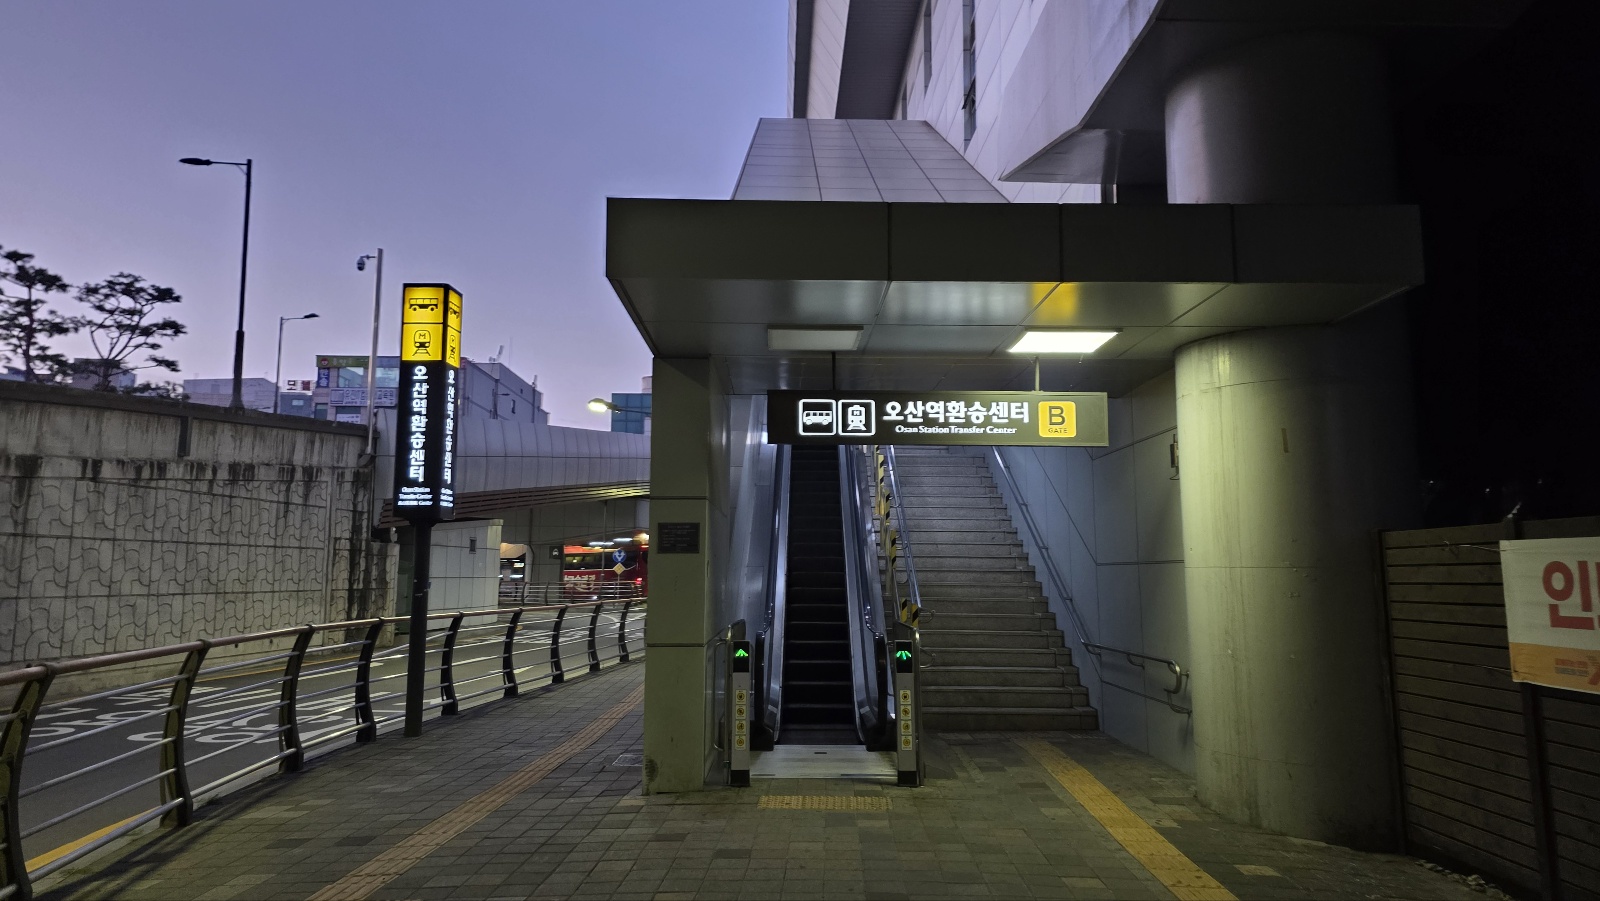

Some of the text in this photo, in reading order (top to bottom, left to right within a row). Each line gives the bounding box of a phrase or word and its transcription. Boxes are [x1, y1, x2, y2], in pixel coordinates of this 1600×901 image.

[409, 365, 430, 482] 오산역환승센터
[882, 400, 1030, 424] 오산역환승센터
[1048, 405, 1066, 426] B
[895, 425, 1017, 435] Osan Station Transfer Center
[1542, 560, 1600, 630] 인
